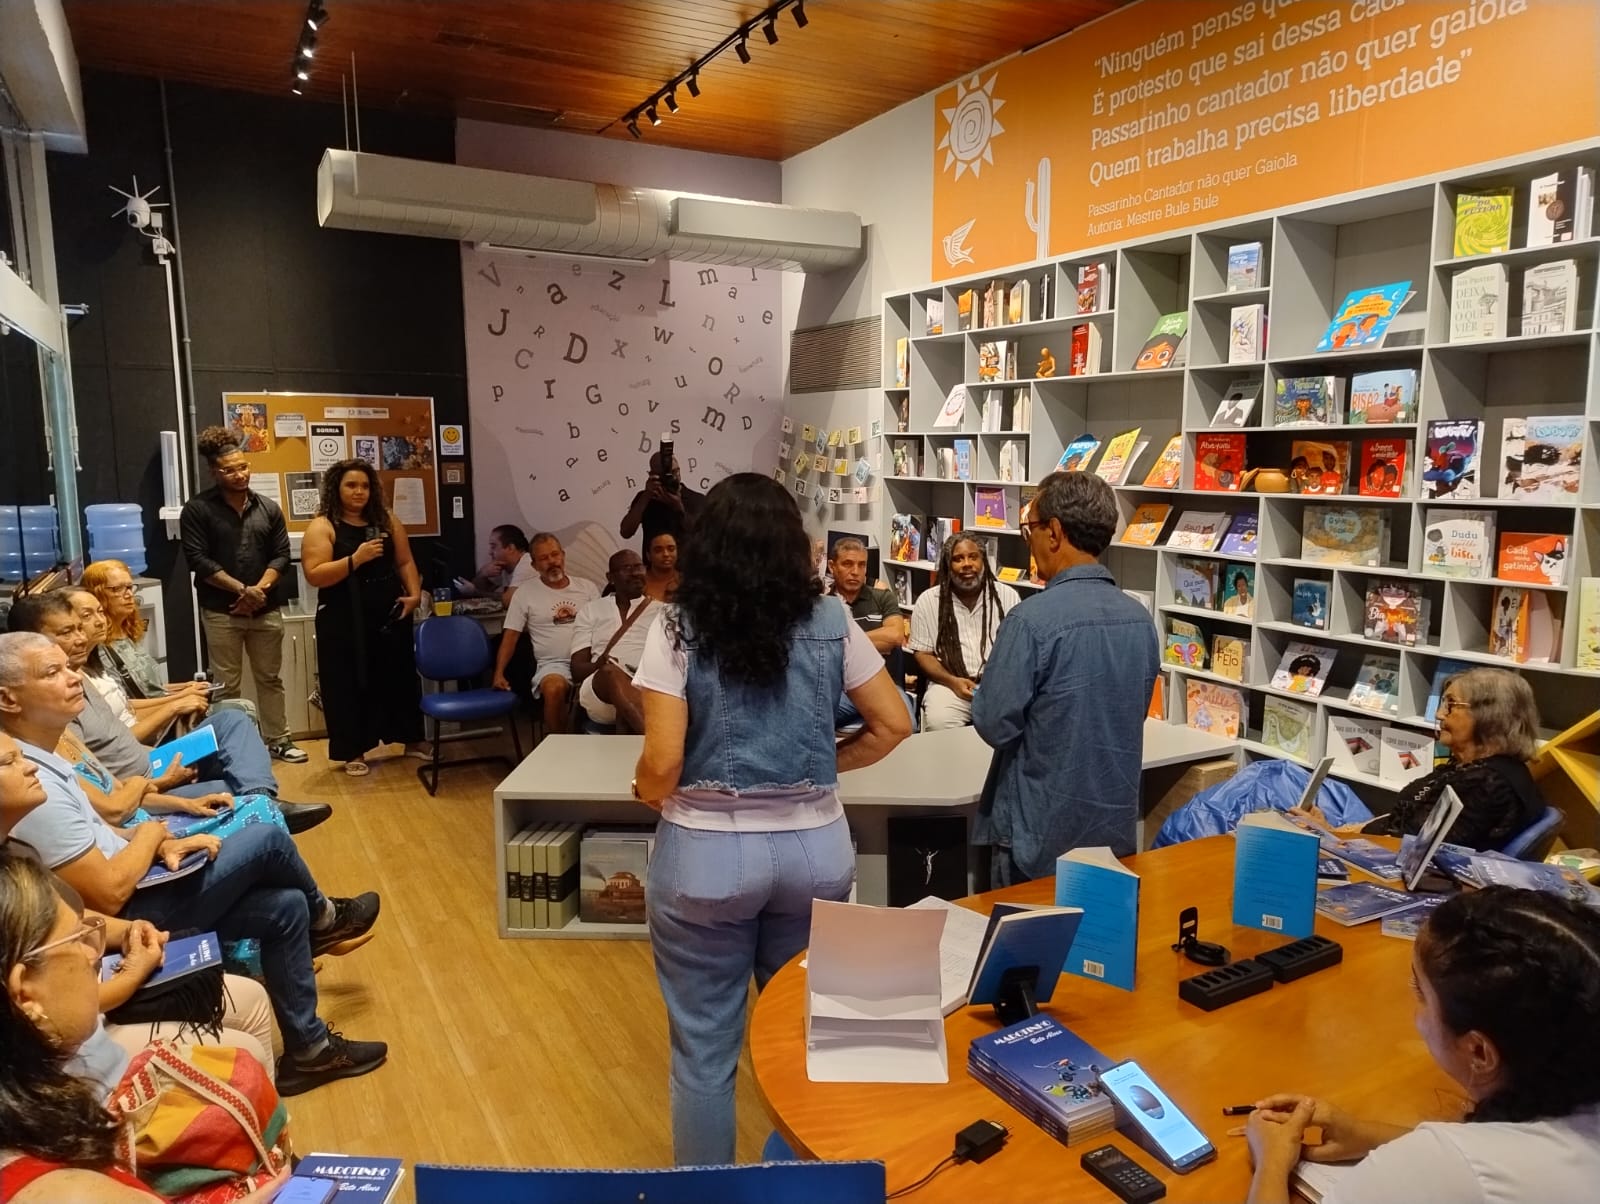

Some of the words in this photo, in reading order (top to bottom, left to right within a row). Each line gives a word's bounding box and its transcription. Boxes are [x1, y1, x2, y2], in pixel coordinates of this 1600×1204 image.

[1094, 32, 1185, 78] “Ninguém
[1191, 2, 1255, 49] pense
[1092, 88, 1105, 115] É
[1108, 68, 1183, 116] protesto
[1188, 52, 1227, 86] que
[1233, 33, 1265, 66] sai
[1272, 9, 1341, 51] dessa
[1091, 102, 1191, 150] Passarinho
[1196, 67, 1293, 116] cantador
[1300, 50, 1348, 83] não
[1355, 24, 1422, 71] quer
[1089, 154, 1140, 187] Quem
[1147, 128, 1228, 169] trabalha
[1234, 101, 1320, 150] precisa
[1329, 48, 1473, 117] liberdade”
[1087, 192, 1142, 217] Passarinho
[1144, 178, 1194, 203] Cantador
[1198, 174, 1220, 189] não
[1222, 165, 1252, 186] quer
[1255, 152, 1298, 175] Gaiola
[1126, 209, 1161, 227] Mestre
[1165, 203, 1190, 218] Bule
[1193, 193, 1219, 212] Bule
[697, 267, 719, 286] m
[546, 282, 568, 305] a
[658, 279, 676, 308] L
[728, 286, 738, 300] a
[487, 308, 510, 336] J
[761, 310, 773, 325] e
[533, 325, 546, 339] R
[563, 331, 588, 364] D
[585, 383, 603, 405] G
[723, 382, 741, 405] R
[567, 421, 581, 439] b
[701, 406, 726, 432] m
[638, 431, 652, 453] b
[597, 448, 608, 462] e
[558, 488, 570, 502] a
[1451, 530, 1478, 539] Dudu
[1502, 561, 1538, 572] gatinha?
[312, 1165, 390, 1177] MAROTINHO
